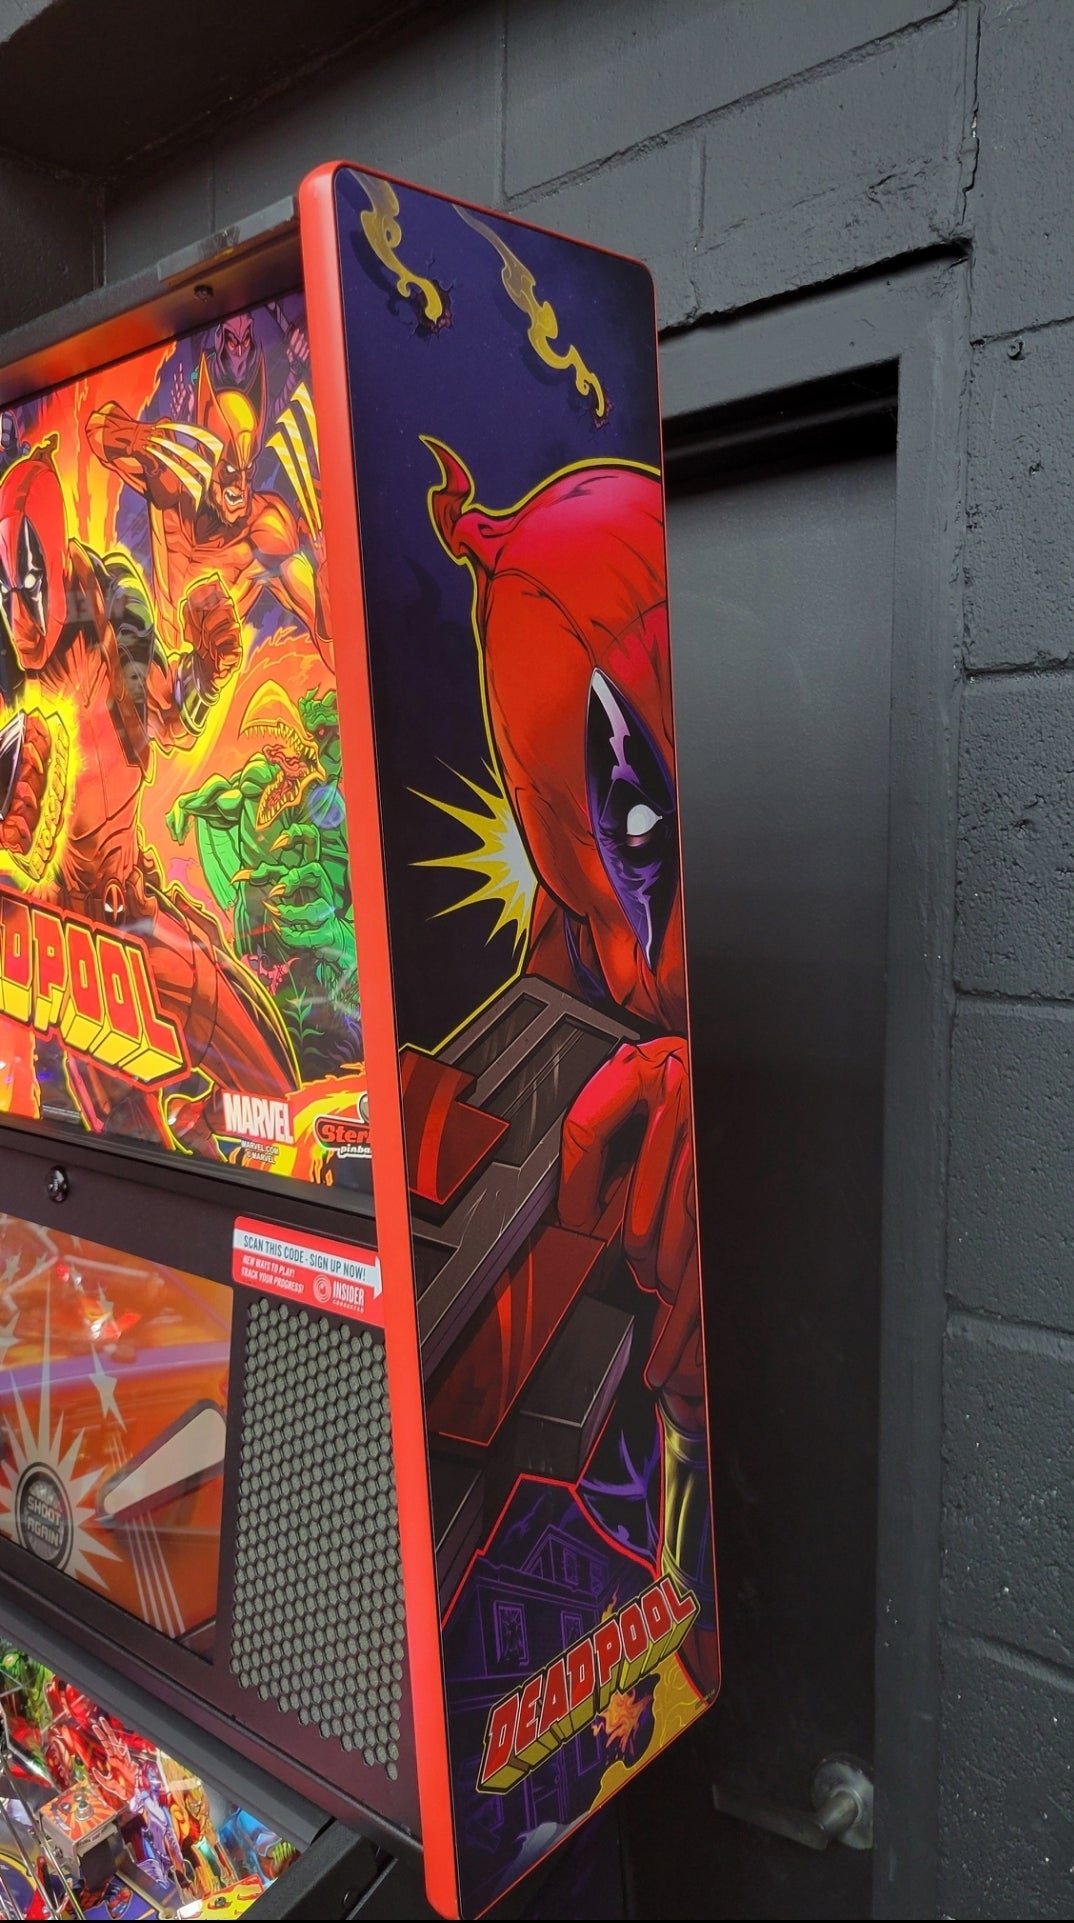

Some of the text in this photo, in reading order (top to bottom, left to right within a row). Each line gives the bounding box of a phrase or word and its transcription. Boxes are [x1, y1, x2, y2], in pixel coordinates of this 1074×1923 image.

[223, 1092, 294, 1144] MARVEL
[241, 1140, 279, 1156] MARVEL.COM
[321, 1124, 371, 1144] Ster
[242, 1254, 296, 1278] NEW WAYS TO PLAY!
[243, 1235, 264, 1251] SCAN
[265, 1241, 282, 1257] THIS
[284, 1246, 304, 1264] CODE
[309, 1253, 328, 1270] SIGN
[330, 1259, 341, 1273] UP
[343, 1264, 366, 1281] NOW!
[241, 1266, 304, 1294] TRACK YOUR PROGRESS!
[333, 1280, 365, 1306] INSIDER
[27, 1495, 61, 1526] SHOOT
[27, 1516, 60, 1547] AGAIN
[478, 1575, 699, 1791] DEADPOOL
